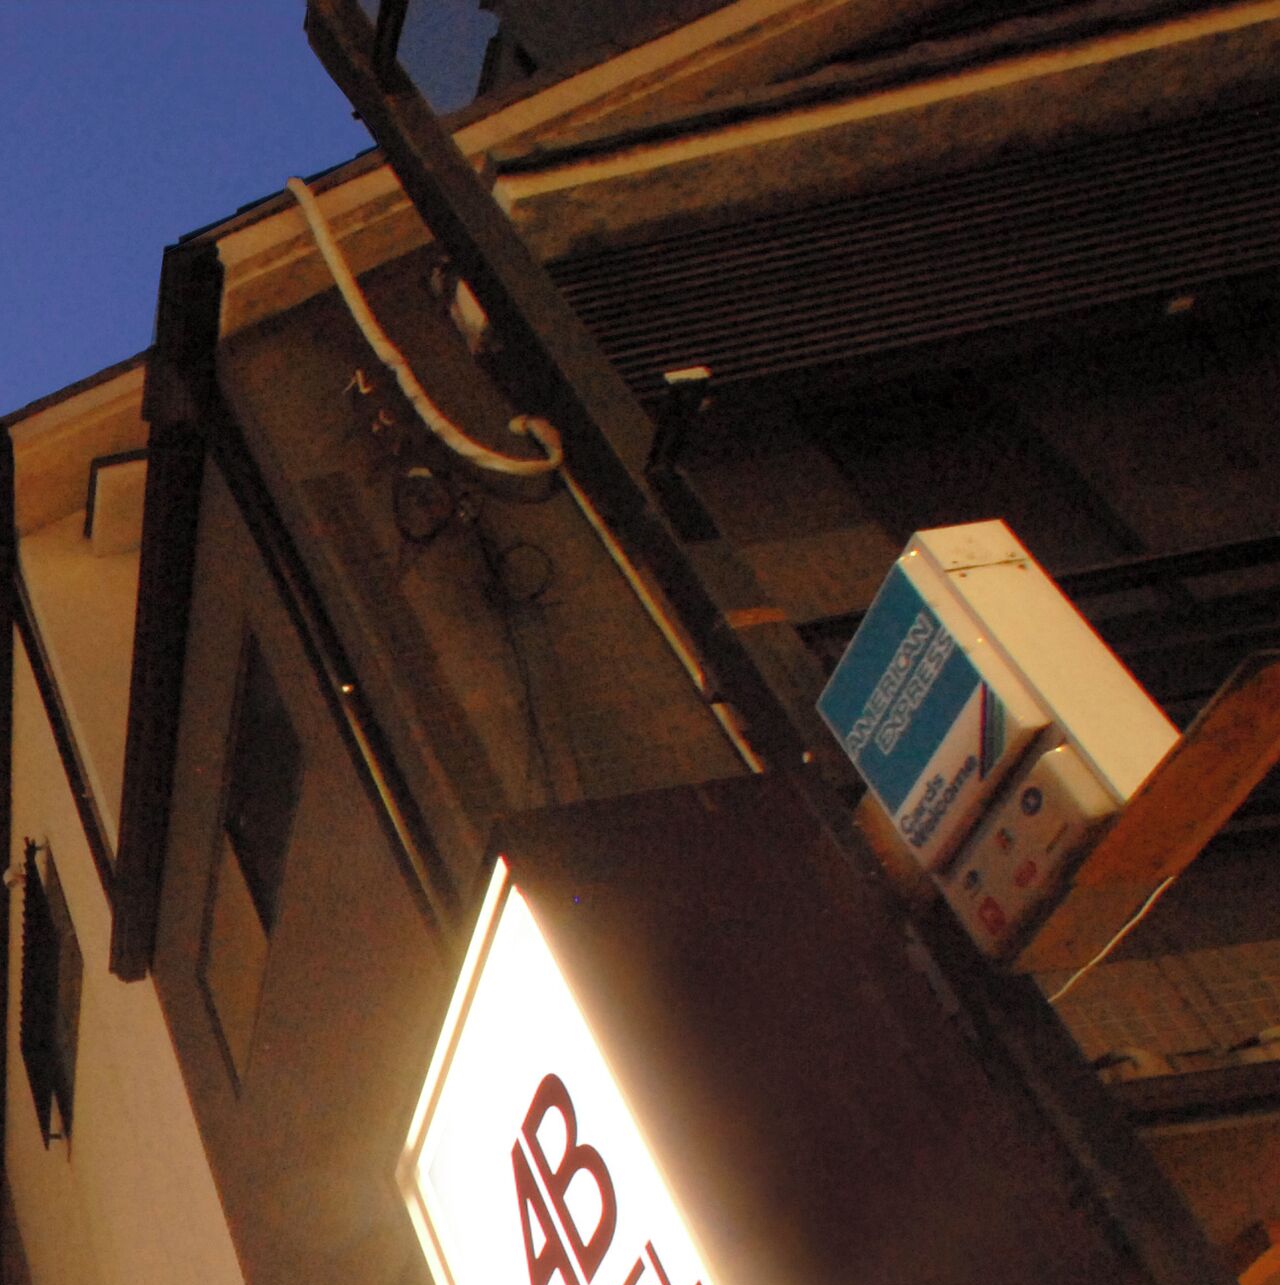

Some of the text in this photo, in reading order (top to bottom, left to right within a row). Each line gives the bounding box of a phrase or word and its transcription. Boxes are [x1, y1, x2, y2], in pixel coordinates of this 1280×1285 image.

[846, 611, 934, 762] AMERICAN
[875, 625, 956, 755] EXPRESS
[902, 775, 944, 835] Cards
